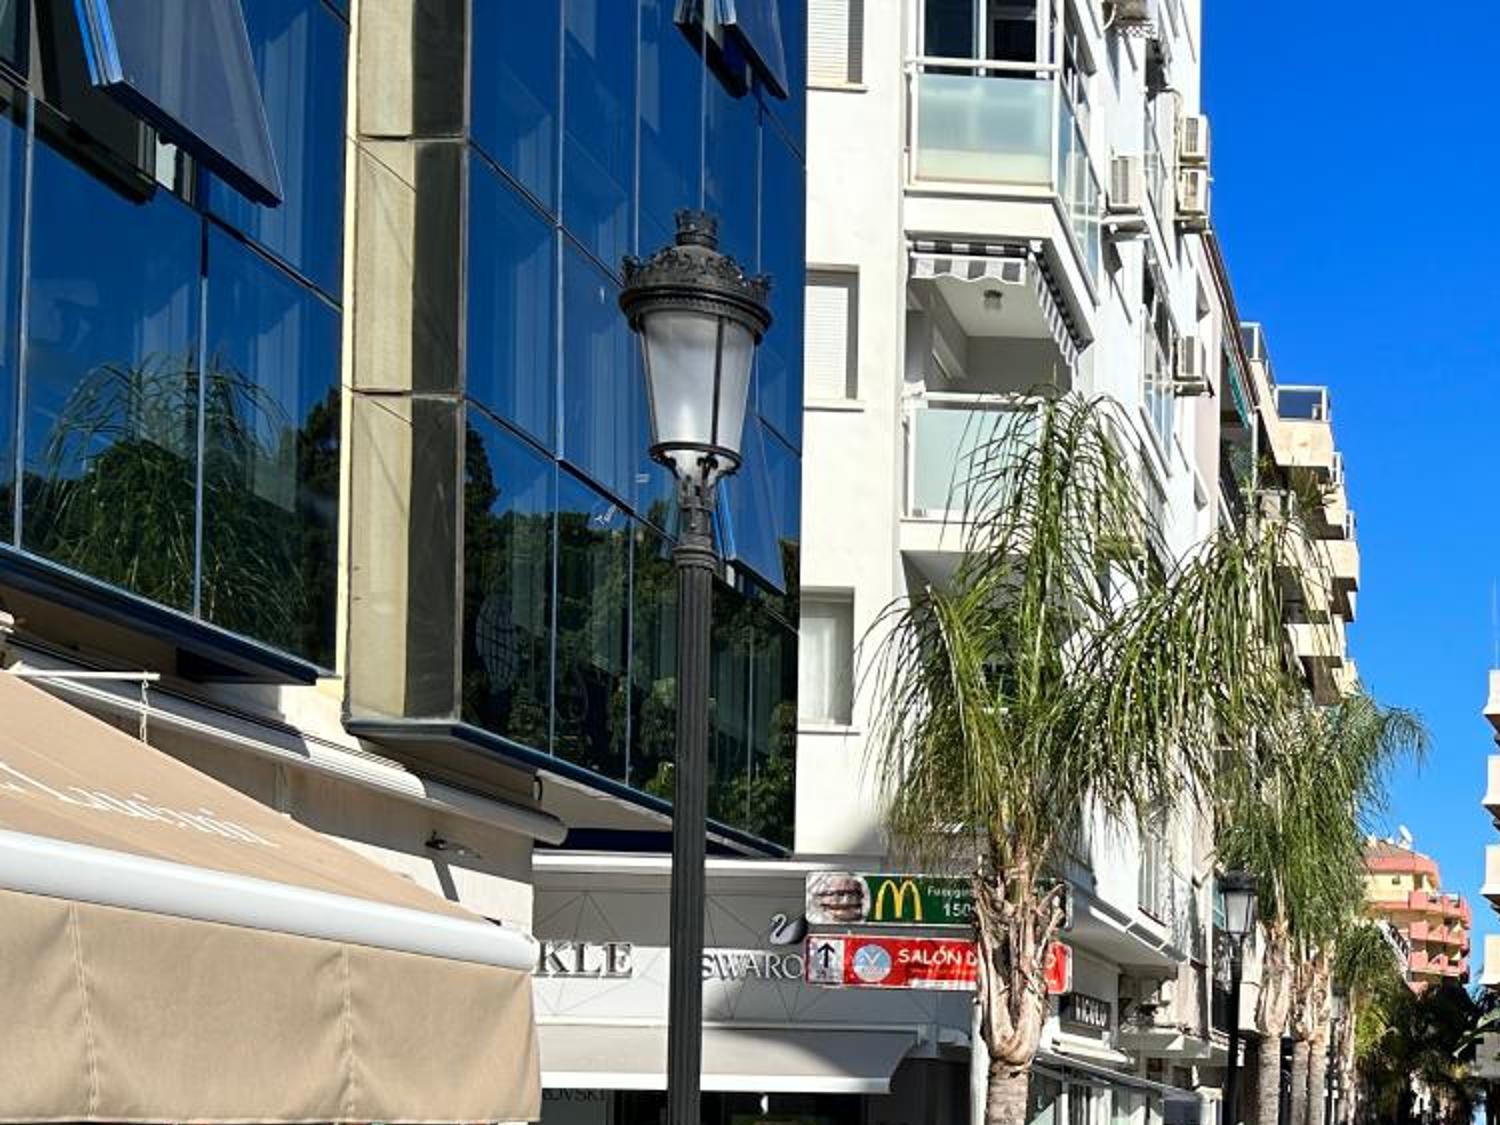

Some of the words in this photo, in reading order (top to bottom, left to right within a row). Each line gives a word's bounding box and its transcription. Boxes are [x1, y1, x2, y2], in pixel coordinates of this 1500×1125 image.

[537, 941, 634, 978] KLE
[701, 950, 804, 981] SWARO
[897, 945, 962, 965] SALÓN
